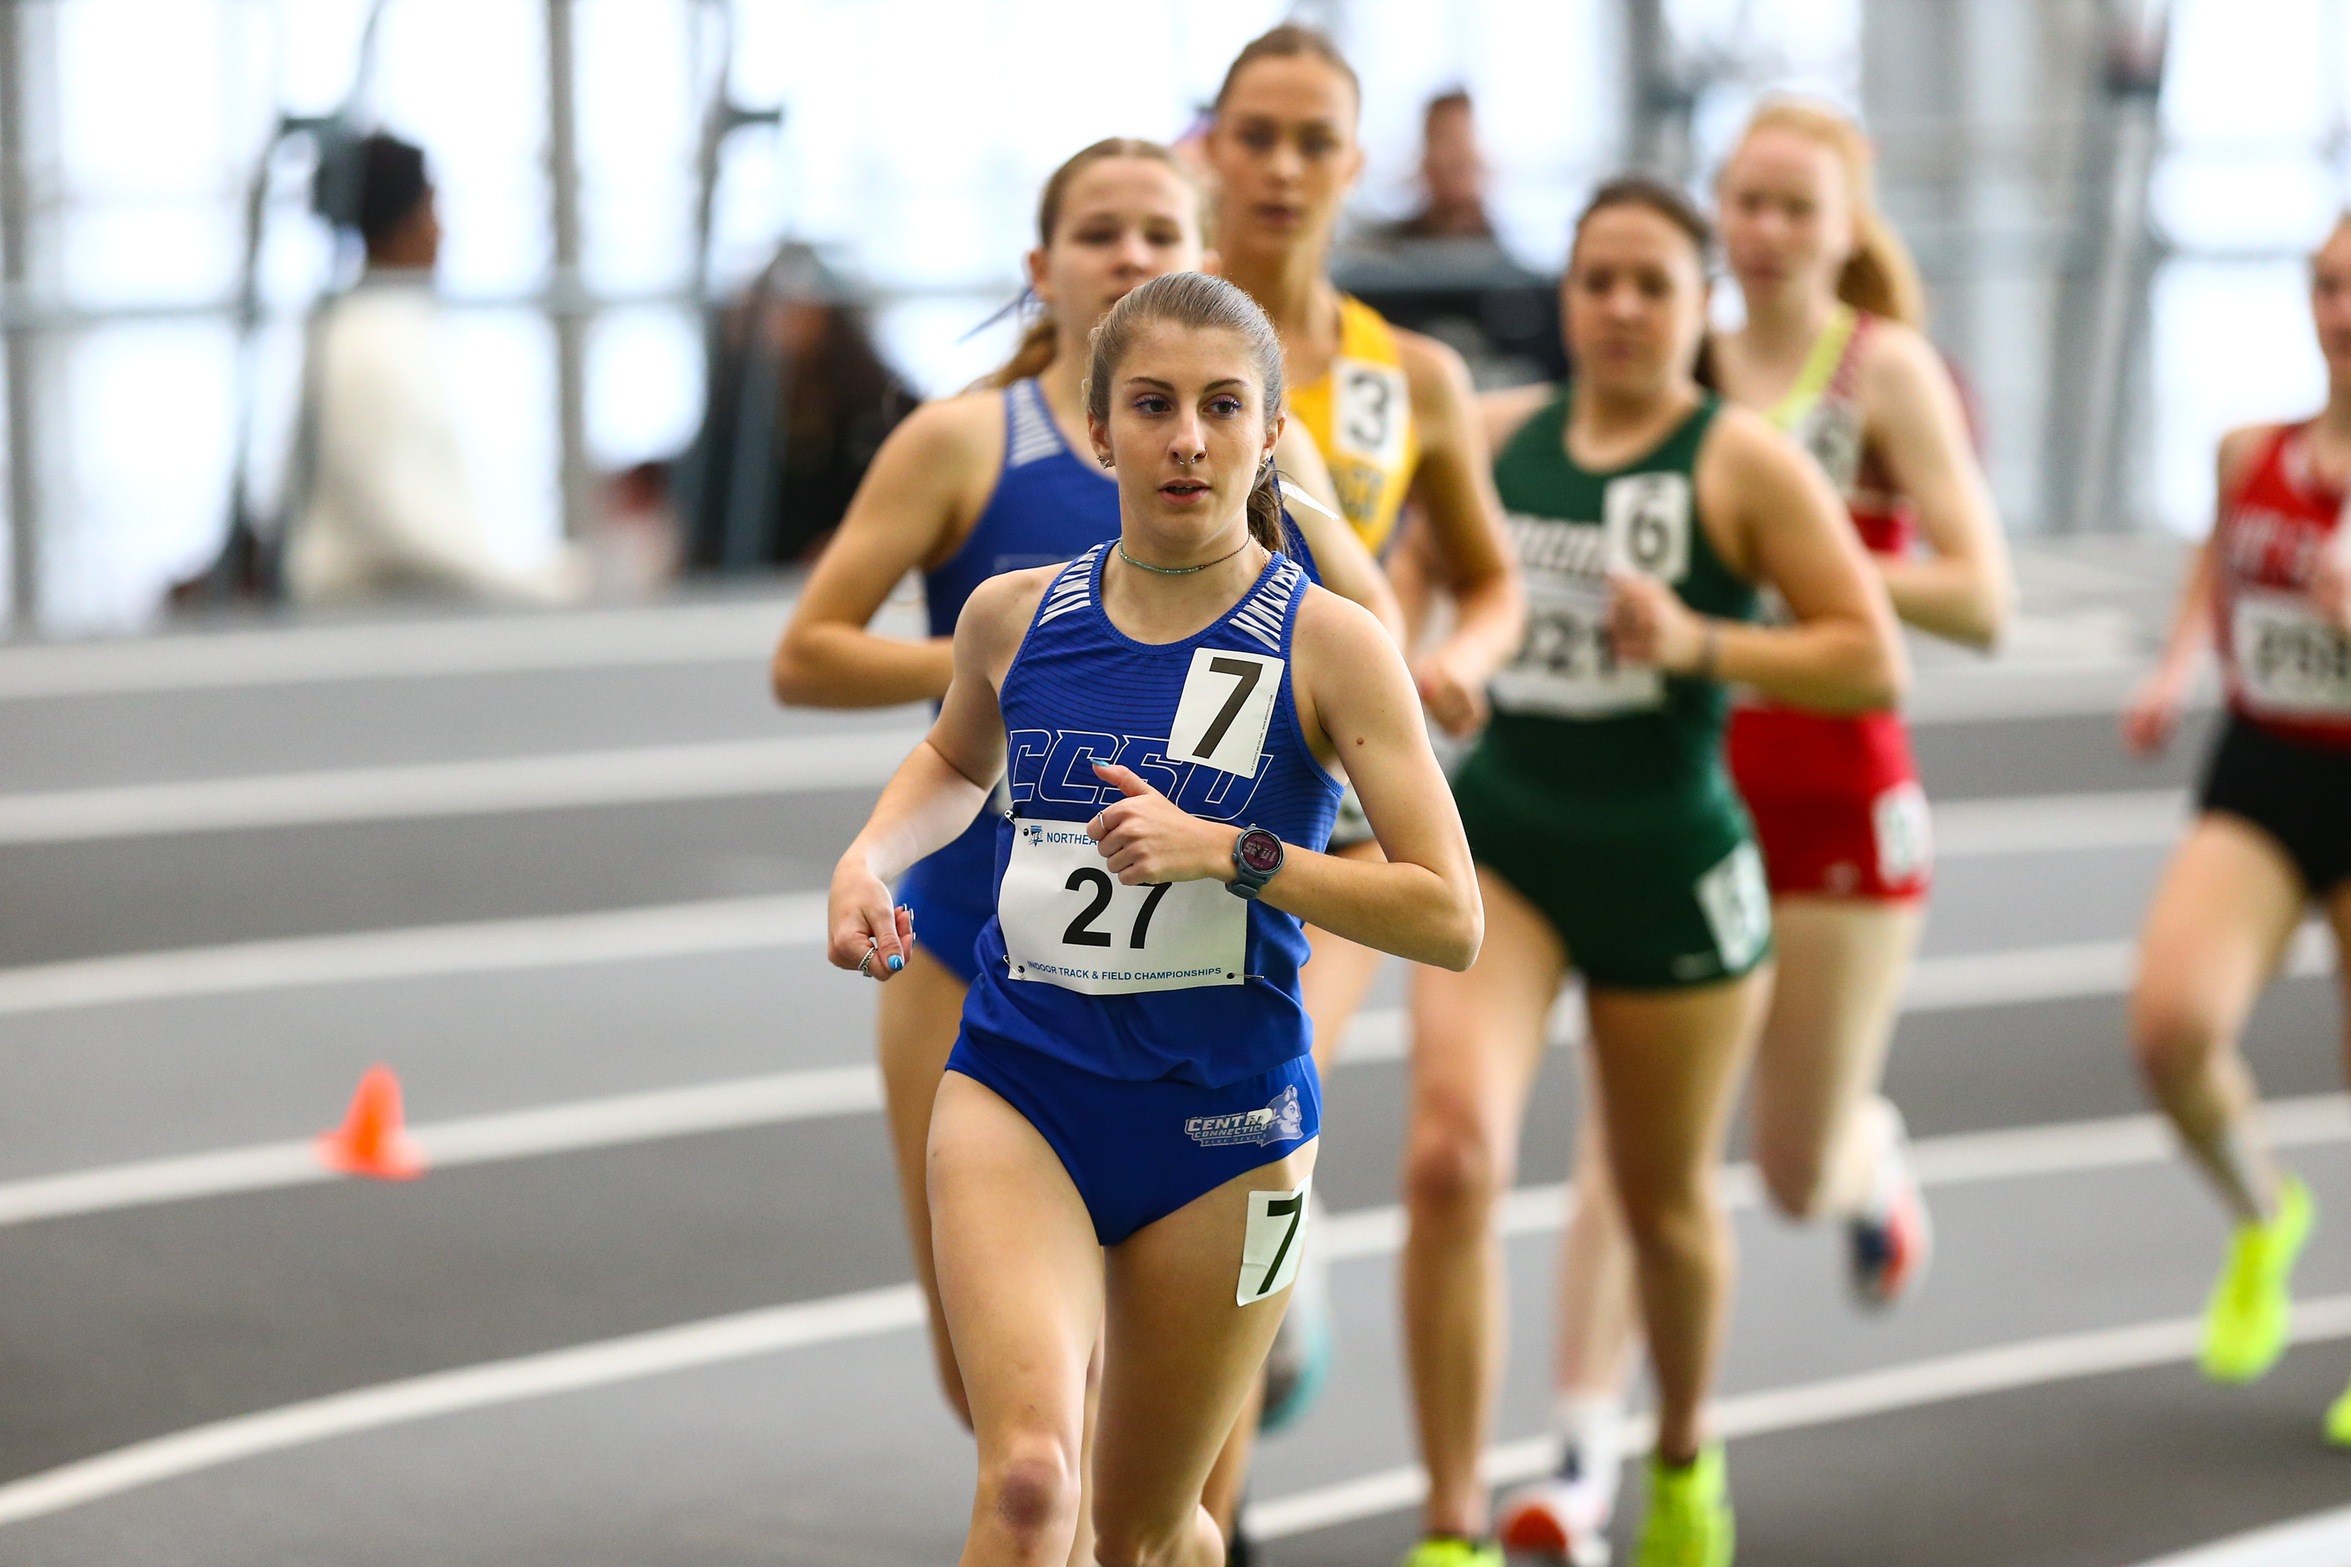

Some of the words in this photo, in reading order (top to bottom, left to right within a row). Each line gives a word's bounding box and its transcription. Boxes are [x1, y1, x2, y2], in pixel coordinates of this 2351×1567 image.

[1348, 371, 1390, 448] 3
[1627, 509, 1670, 570] 6
[1192, 657, 1263, 759] 7
[1009, 729, 1274, 821] CCSU
[1062, 867, 1172, 949] 27
[1027, 960, 1057, 975] INDOOR
[1059, 967, 1089, 979] TRACK
[1091, 970, 1099, 979] &
[1101, 971, 1132, 980] FIELD
[1134, 967, 1222, 980] CHAMPIONSHIPS
[1194, 1122, 1275, 1138] CONNECTICUT
[1256, 1191, 1303, 1296] 7
